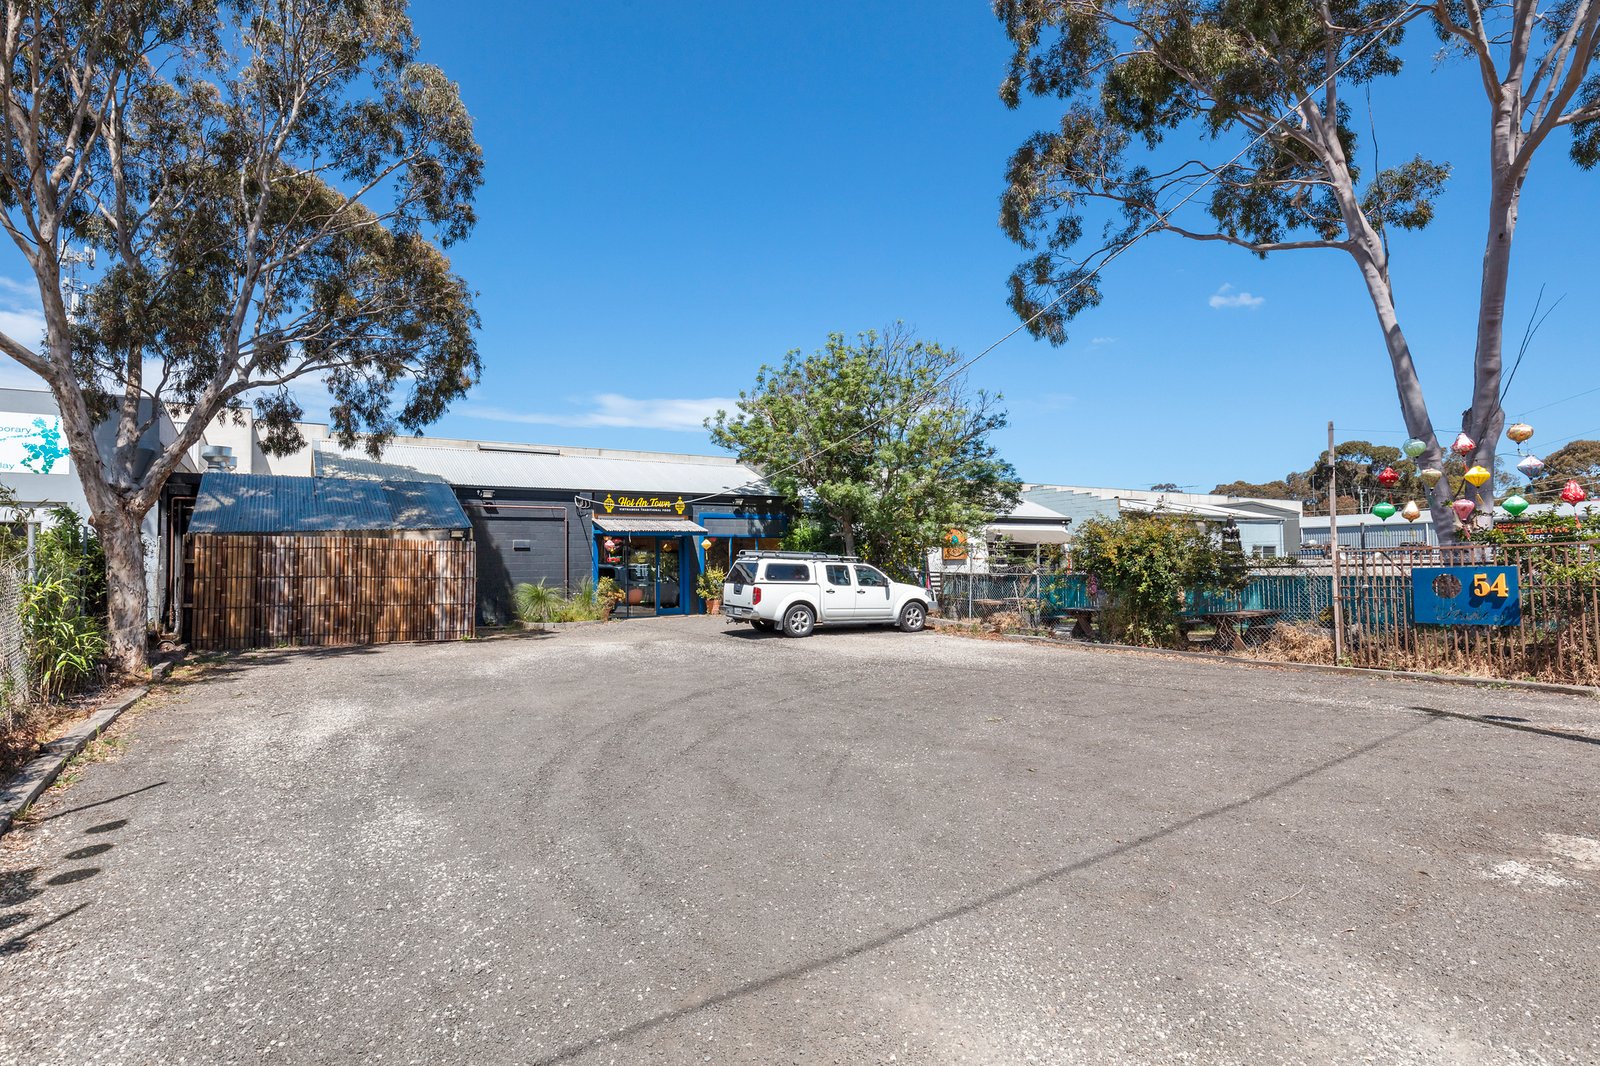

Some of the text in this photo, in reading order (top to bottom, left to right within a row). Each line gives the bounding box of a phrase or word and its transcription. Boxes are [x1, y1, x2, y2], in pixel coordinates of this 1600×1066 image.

[618, 497, 671, 508] Hoi An Town
[1473, 573, 1509, 598] 54
